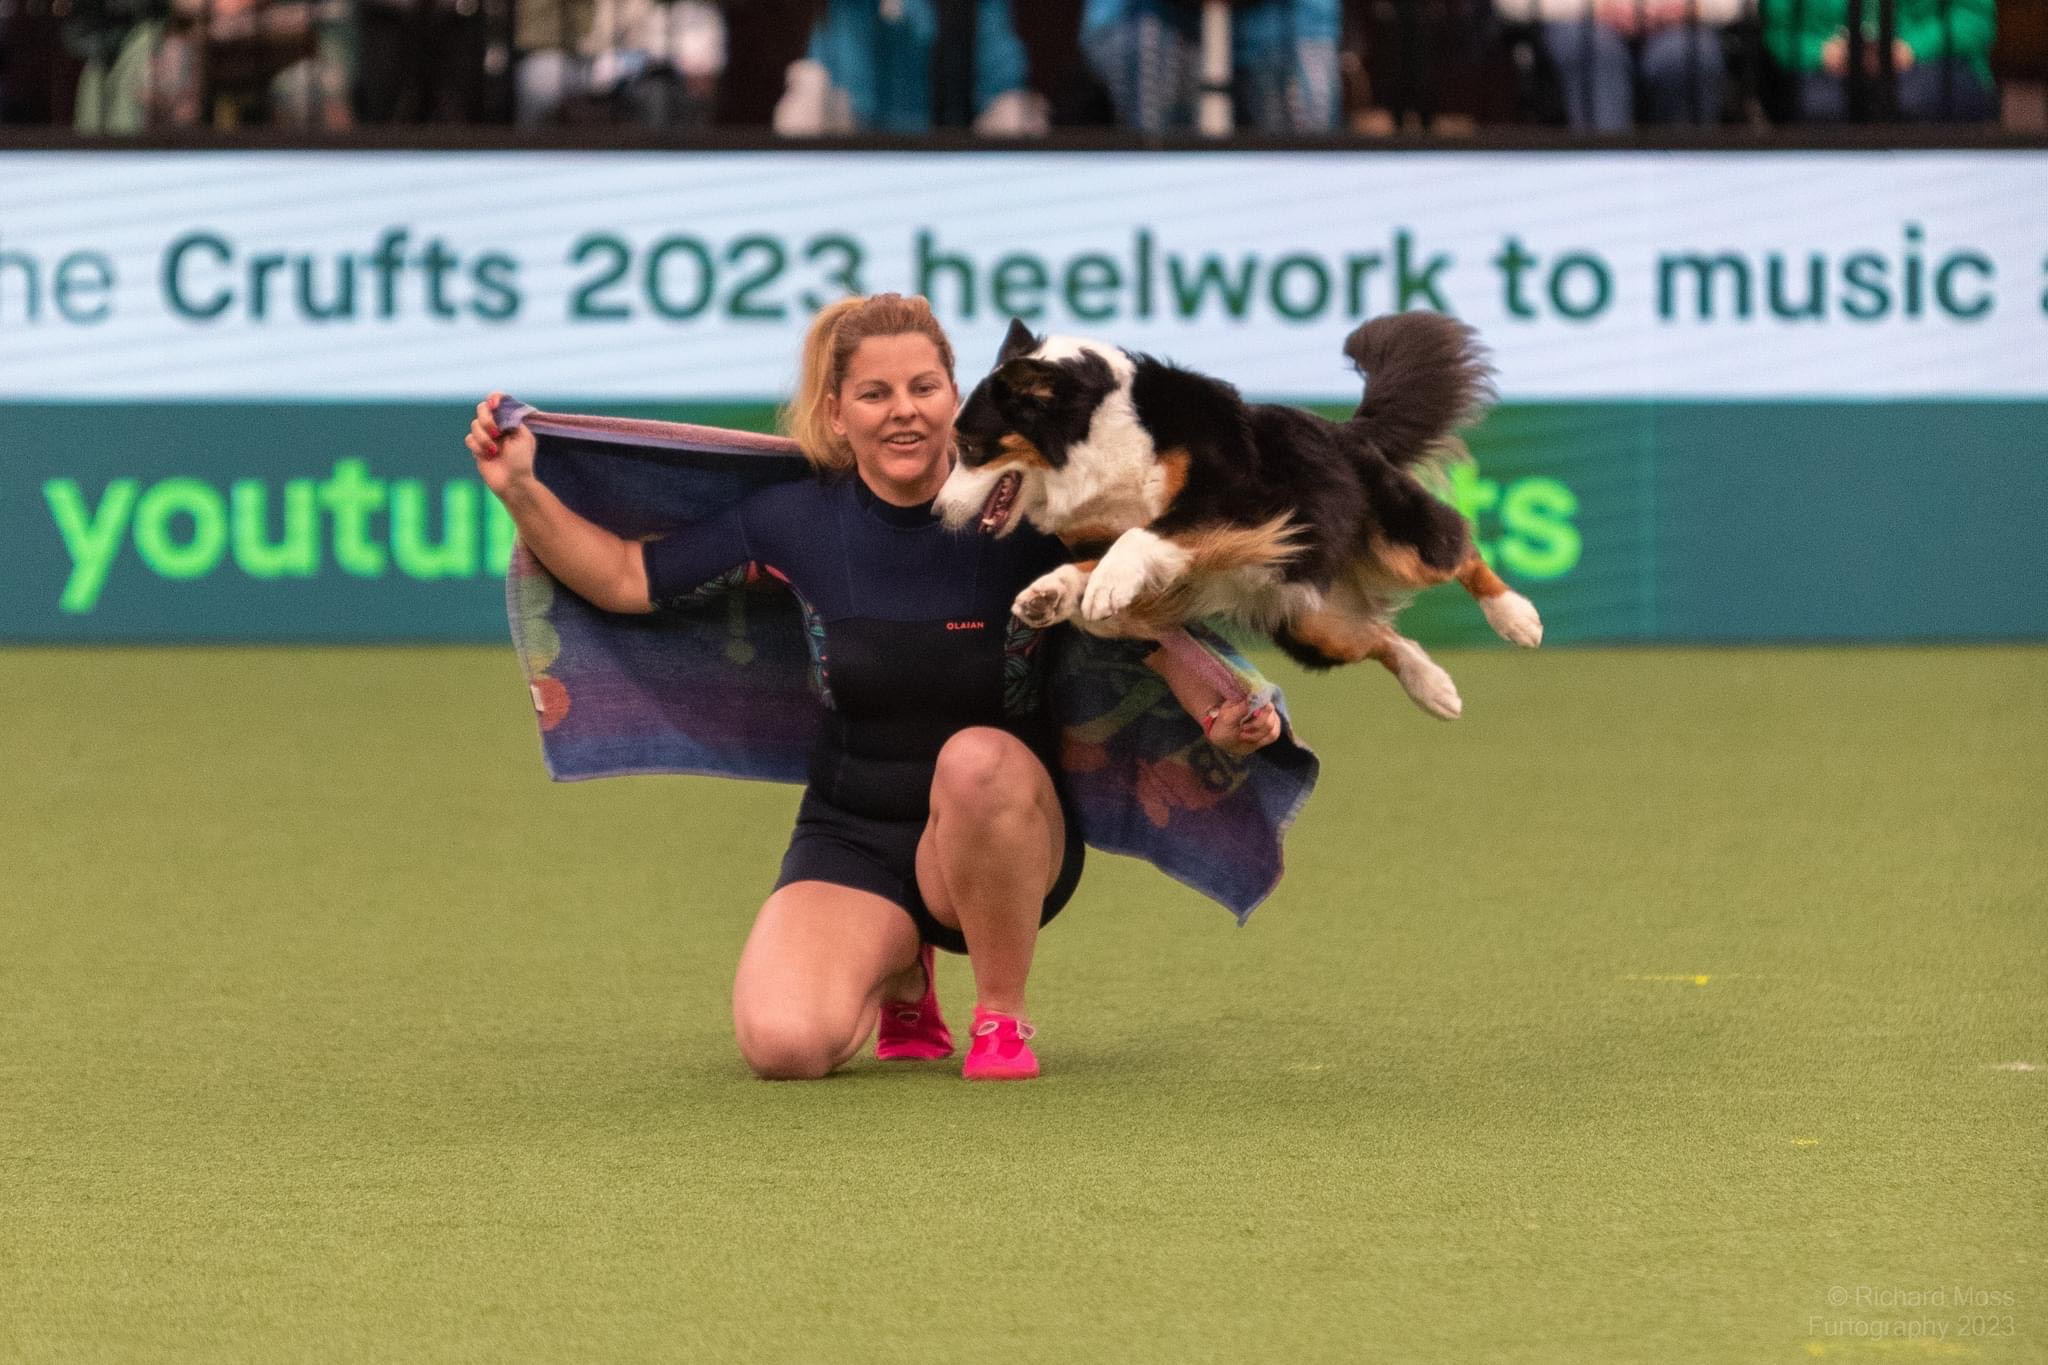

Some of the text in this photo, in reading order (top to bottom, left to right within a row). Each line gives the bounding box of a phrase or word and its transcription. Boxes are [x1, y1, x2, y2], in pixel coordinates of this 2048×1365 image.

[161, 227, 522, 321] Crufts
[566, 232, 865, 320] 2023
[914, 227, 1454, 320] heelwork
[1493, 236, 1614, 320] to
[1657, 223, 1996, 321] music
[43, 459, 1583, 612] youtu ts
[945, 621, 985, 631] OLAIAN
